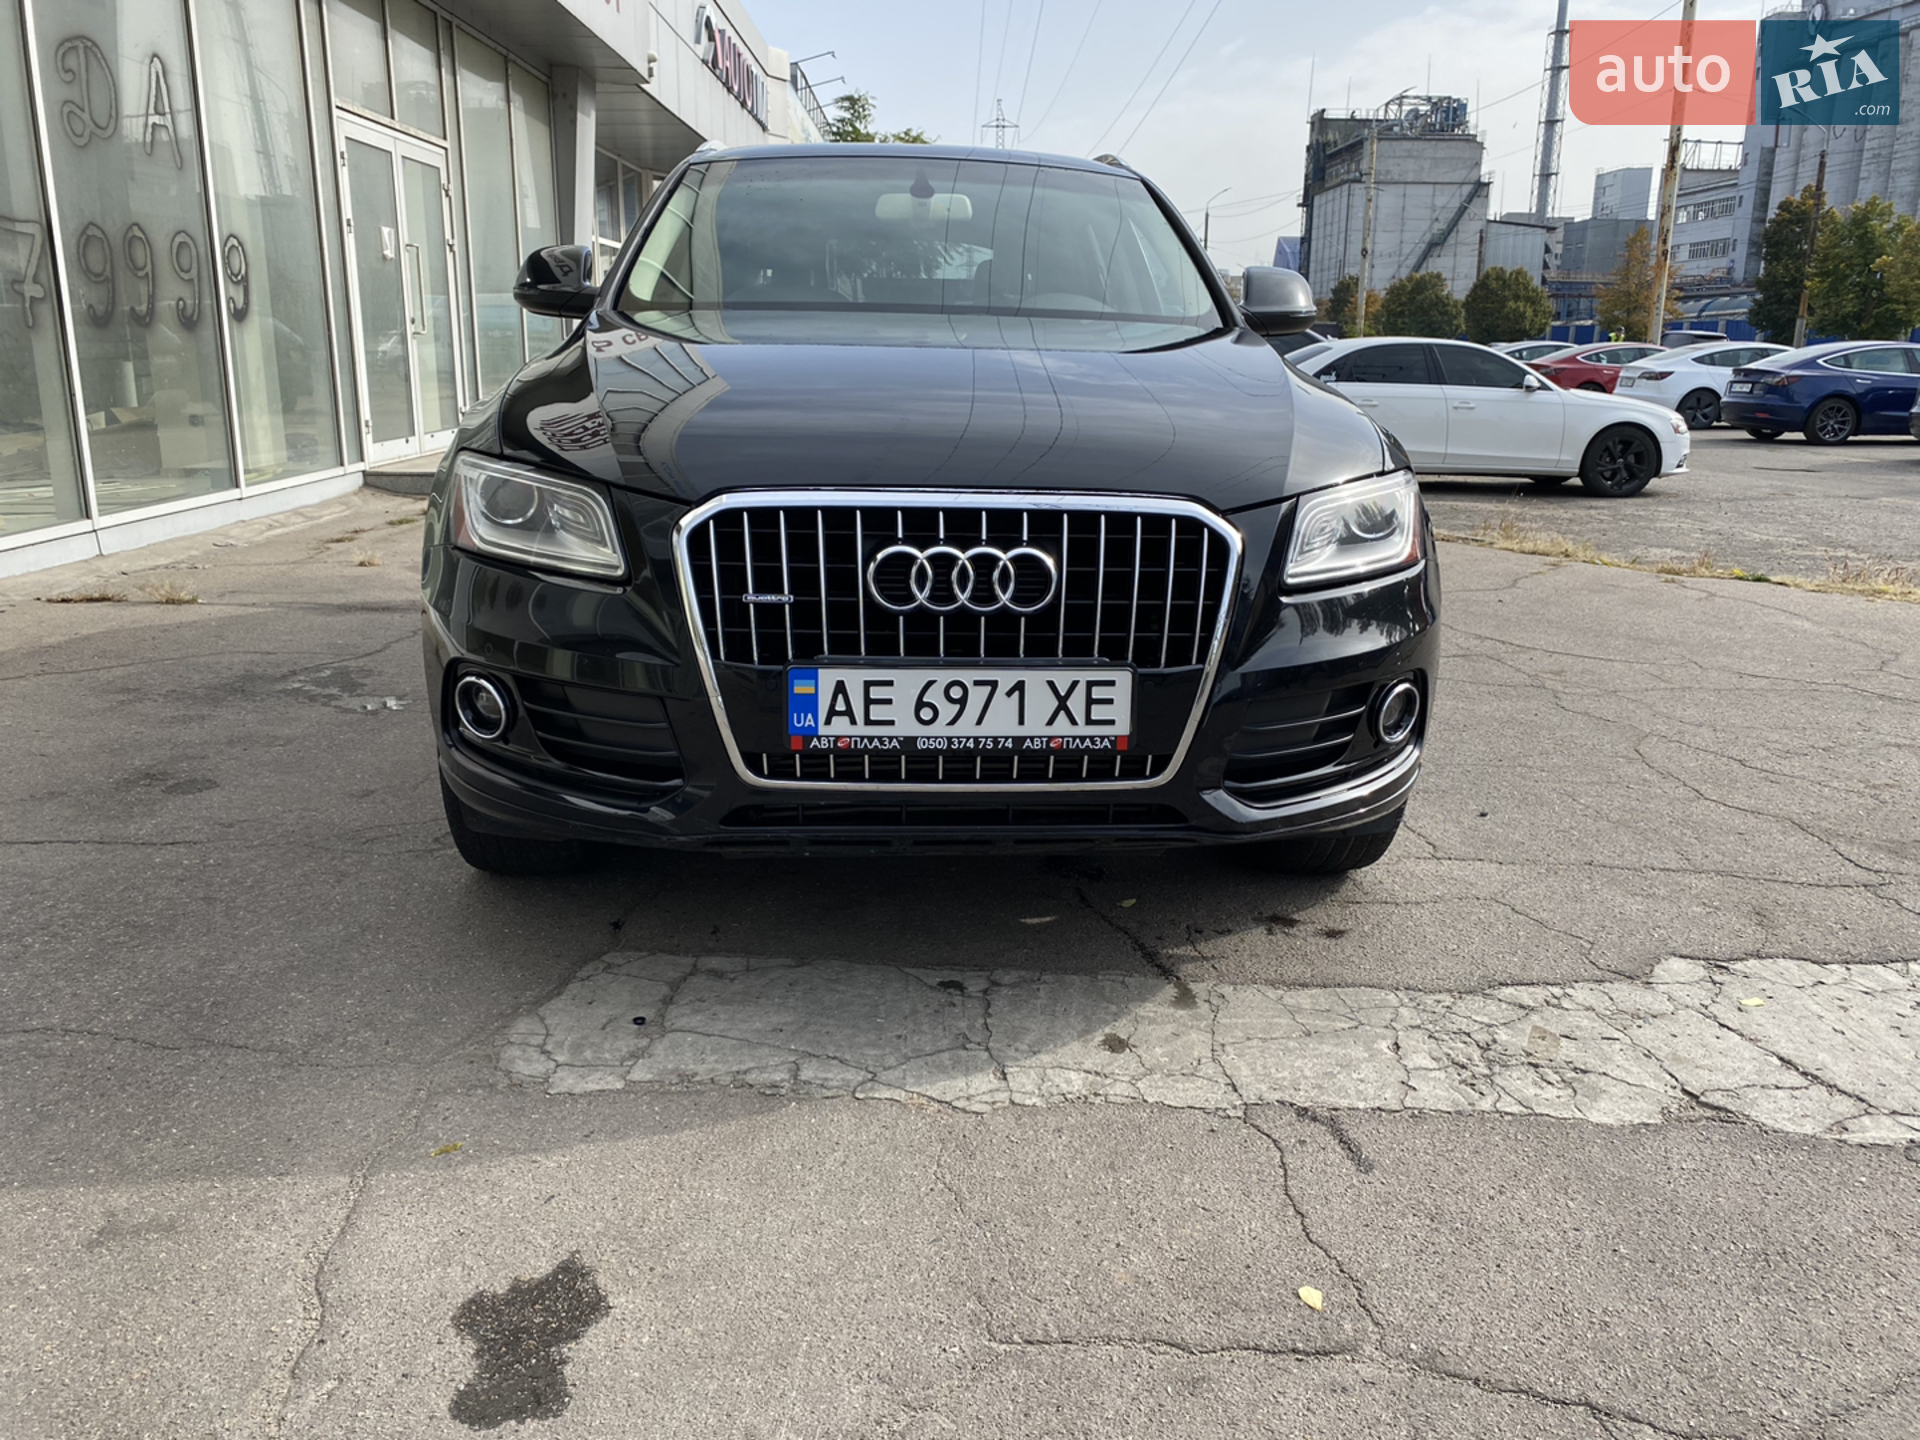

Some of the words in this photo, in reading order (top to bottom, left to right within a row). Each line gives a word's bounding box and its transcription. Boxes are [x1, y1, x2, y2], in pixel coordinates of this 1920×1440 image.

[823, 679, 896, 726] AE
[913, 679, 1026, 726] 6971
[1045, 679, 1117, 726] XE
[793, 713, 816, 728] UA
[916, 737, 948, 750] (050)
[951, 738, 974, 749] 374
[978, 738, 994, 749] 75
[997, 738, 1013, 749] 74
